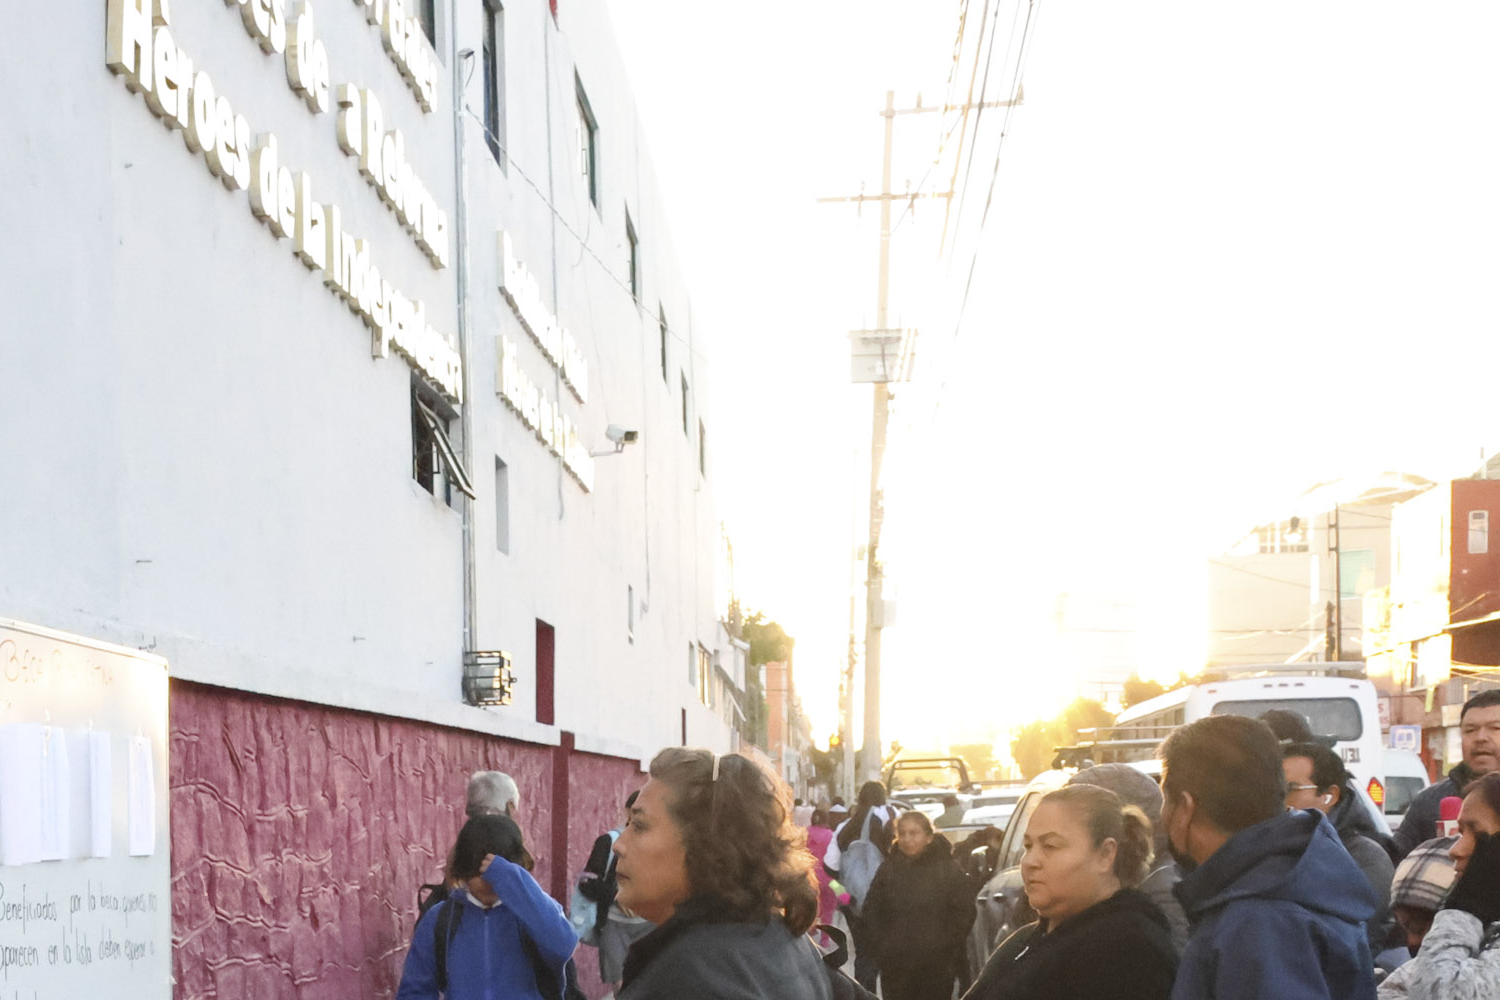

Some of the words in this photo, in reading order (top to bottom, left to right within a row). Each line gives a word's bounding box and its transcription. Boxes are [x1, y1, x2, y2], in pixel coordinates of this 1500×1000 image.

[254, 132, 296, 239] de
[295, 170, 326, 268] la
[47, 944, 59, 965] en
[62, 925, 72, 965] la
[75, 927, 93, 967] lista
